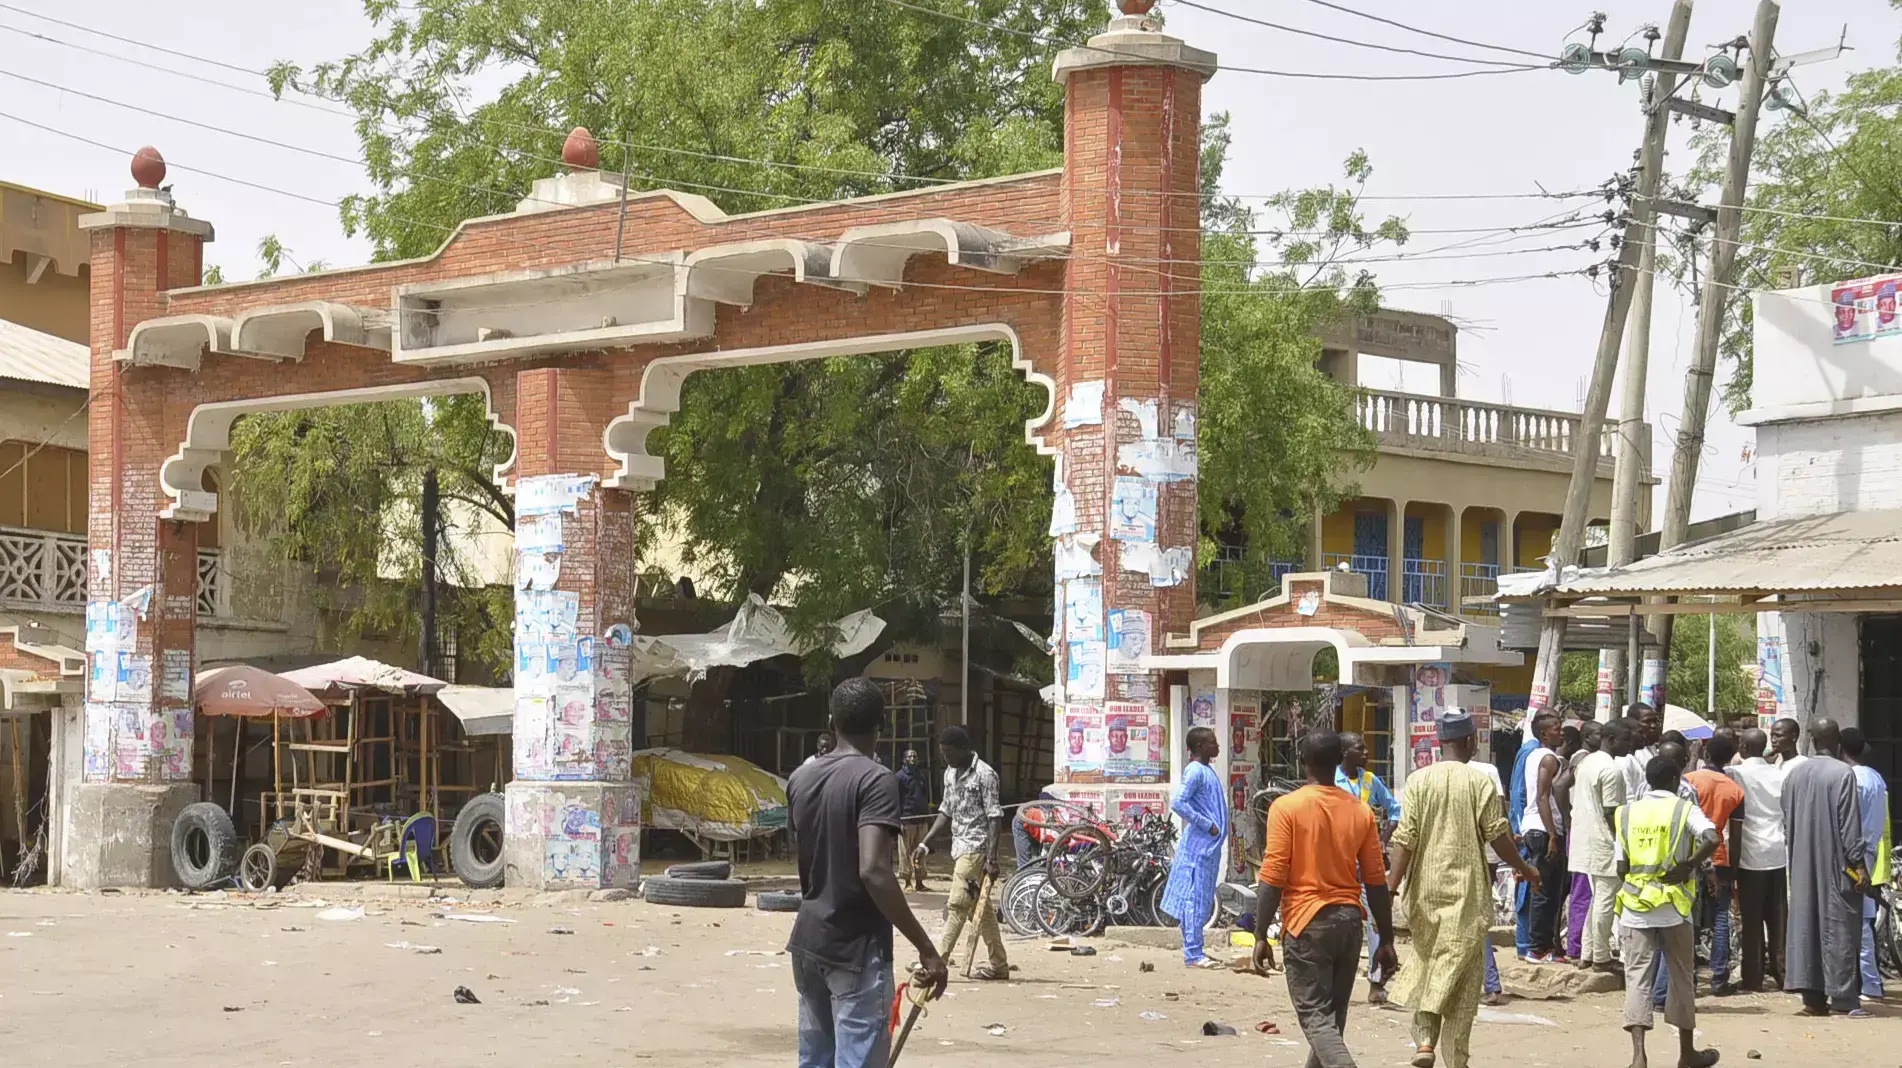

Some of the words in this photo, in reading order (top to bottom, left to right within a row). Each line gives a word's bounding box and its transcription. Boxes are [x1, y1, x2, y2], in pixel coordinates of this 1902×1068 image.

[221, 689, 252, 699] airtel
[1109, 705, 1122, 713] OUR
[1123, 705, 1145, 713] LEADER
[1123, 792, 1137, 800] OUR
[1138, 792, 1161, 800] LEADER
